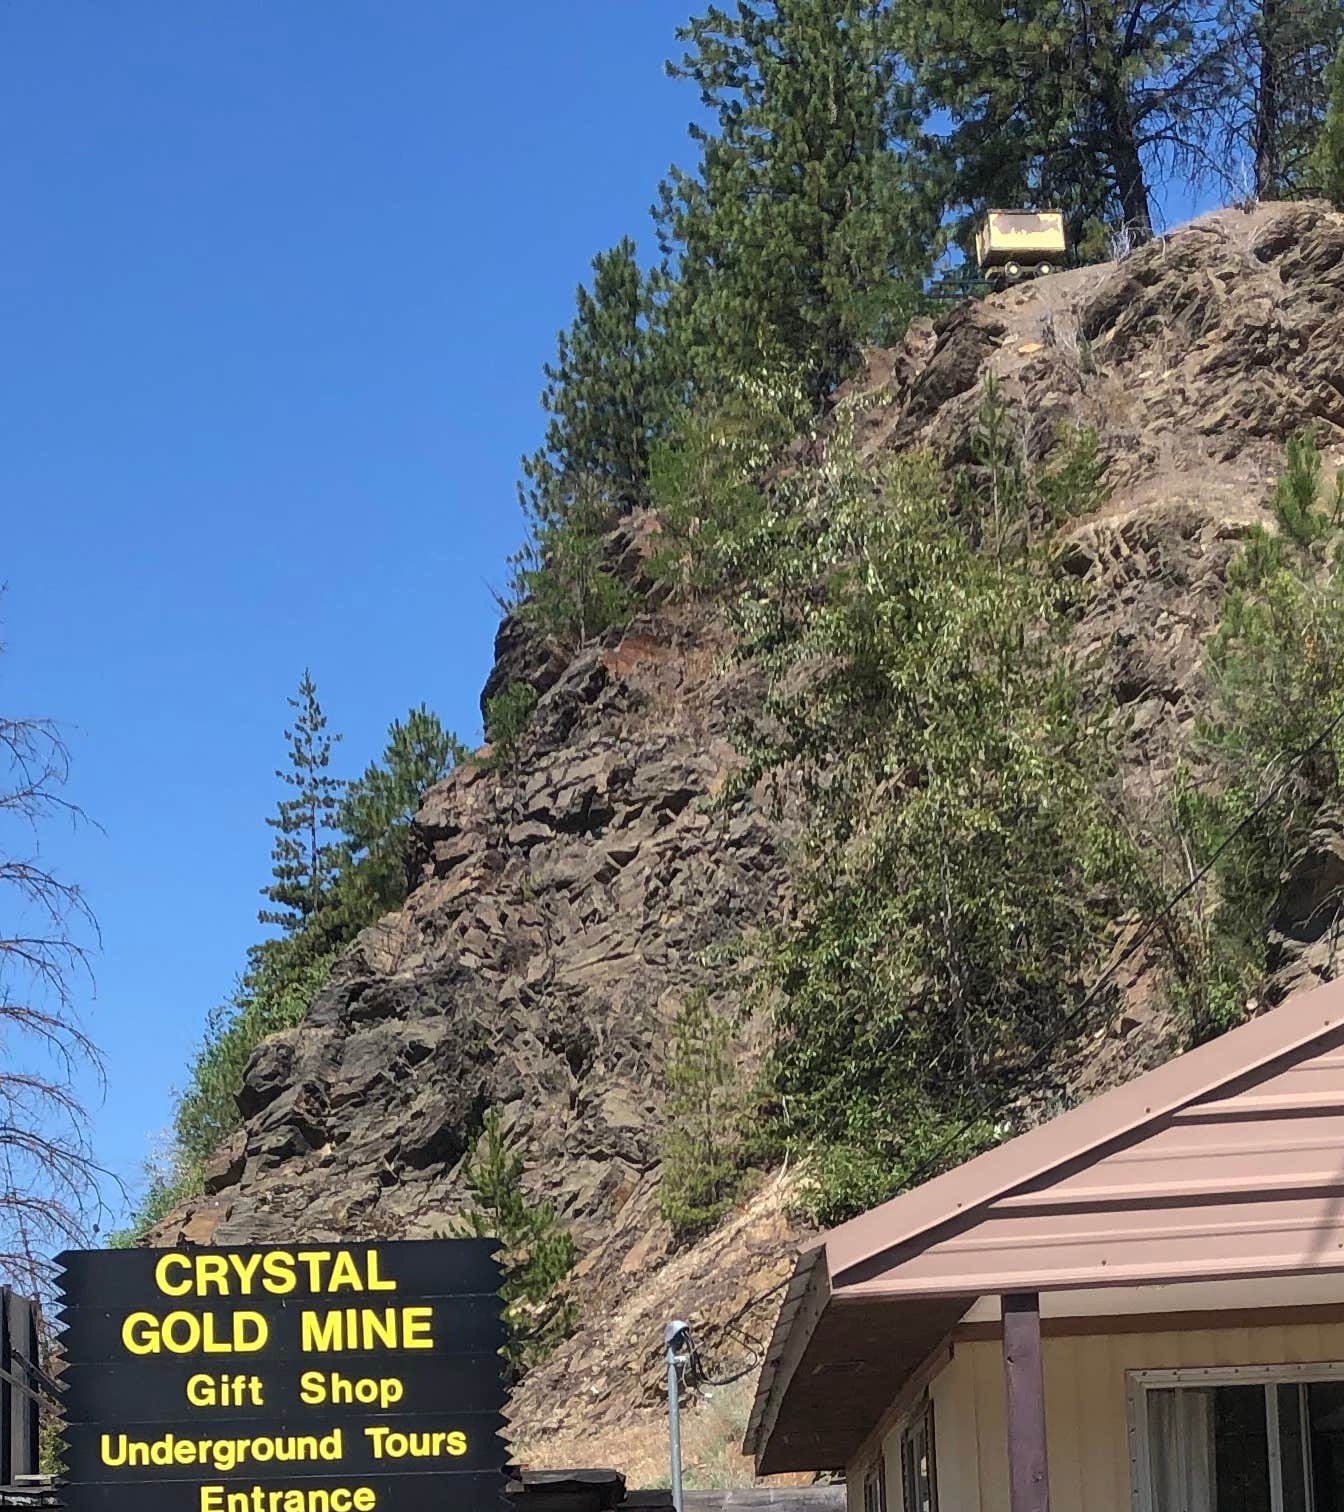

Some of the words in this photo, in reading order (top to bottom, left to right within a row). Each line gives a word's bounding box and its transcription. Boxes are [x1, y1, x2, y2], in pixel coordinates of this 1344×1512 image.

[156, 1250, 396, 1296] CRYSTAL
[122, 1311, 268, 1354] GOLD
[302, 1308, 433, 1351] MINE
[187, 1374, 263, 1406] Gift
[300, 1372, 404, 1408] Shop
[102, 1429, 342, 1470] Underground
[365, 1427, 467, 1459] Tours
